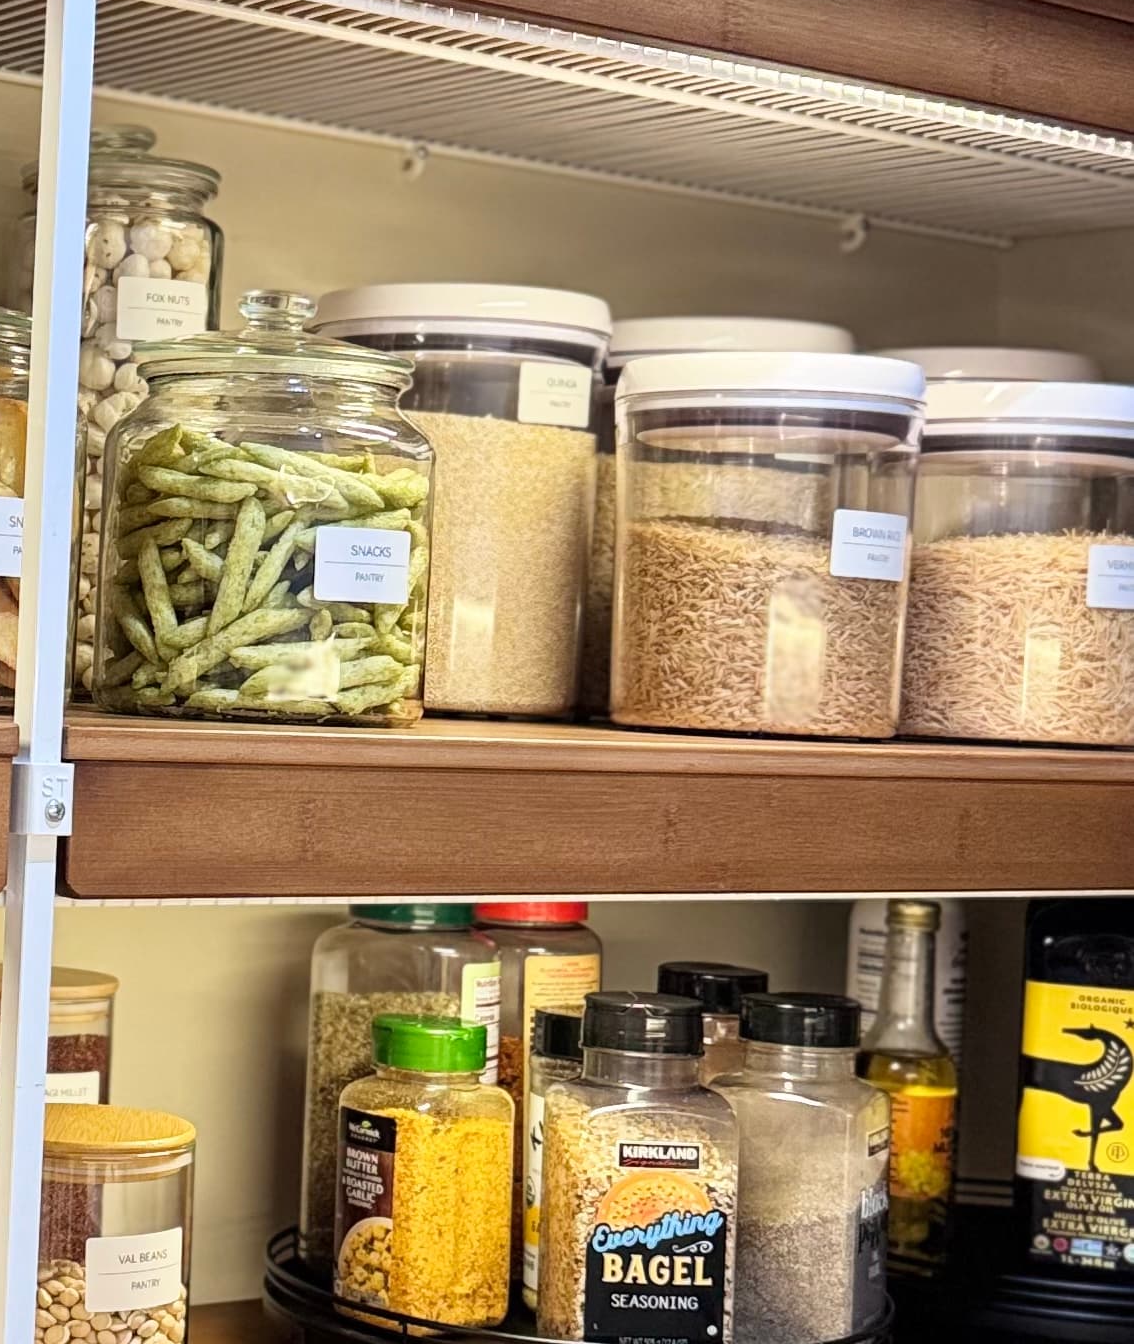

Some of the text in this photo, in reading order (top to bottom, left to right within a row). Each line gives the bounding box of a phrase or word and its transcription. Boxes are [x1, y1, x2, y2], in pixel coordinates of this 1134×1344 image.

[146, 292, 191, 306] FOX NUTS
[350, 544, 392, 558] SNACKS
[354, 572, 385, 583] PANTRY
[41, 776, 69, 799] ST
[1078, 995, 1126, 1006] ORGANIC
[1070, 1002, 1134, 1015] BIOLOGIQUE
[347, 1146, 379, 1164] BROWN
[622, 1145, 698, 1161] KIRKLAND
[346, 1157, 378, 1175] BUTTER
[1044, 1189, 1087, 1204] EXTRA
[592, 1210, 724, 1253] Everything
[1042, 1217, 1085, 1233] EXTRA
[118, 1249, 168, 1264] VAL BEANS
[602, 1252, 714, 1287] BAGEL
[131, 1278, 161, 1290] PANTRY
[611, 1293, 699, 1311] SEASONING
